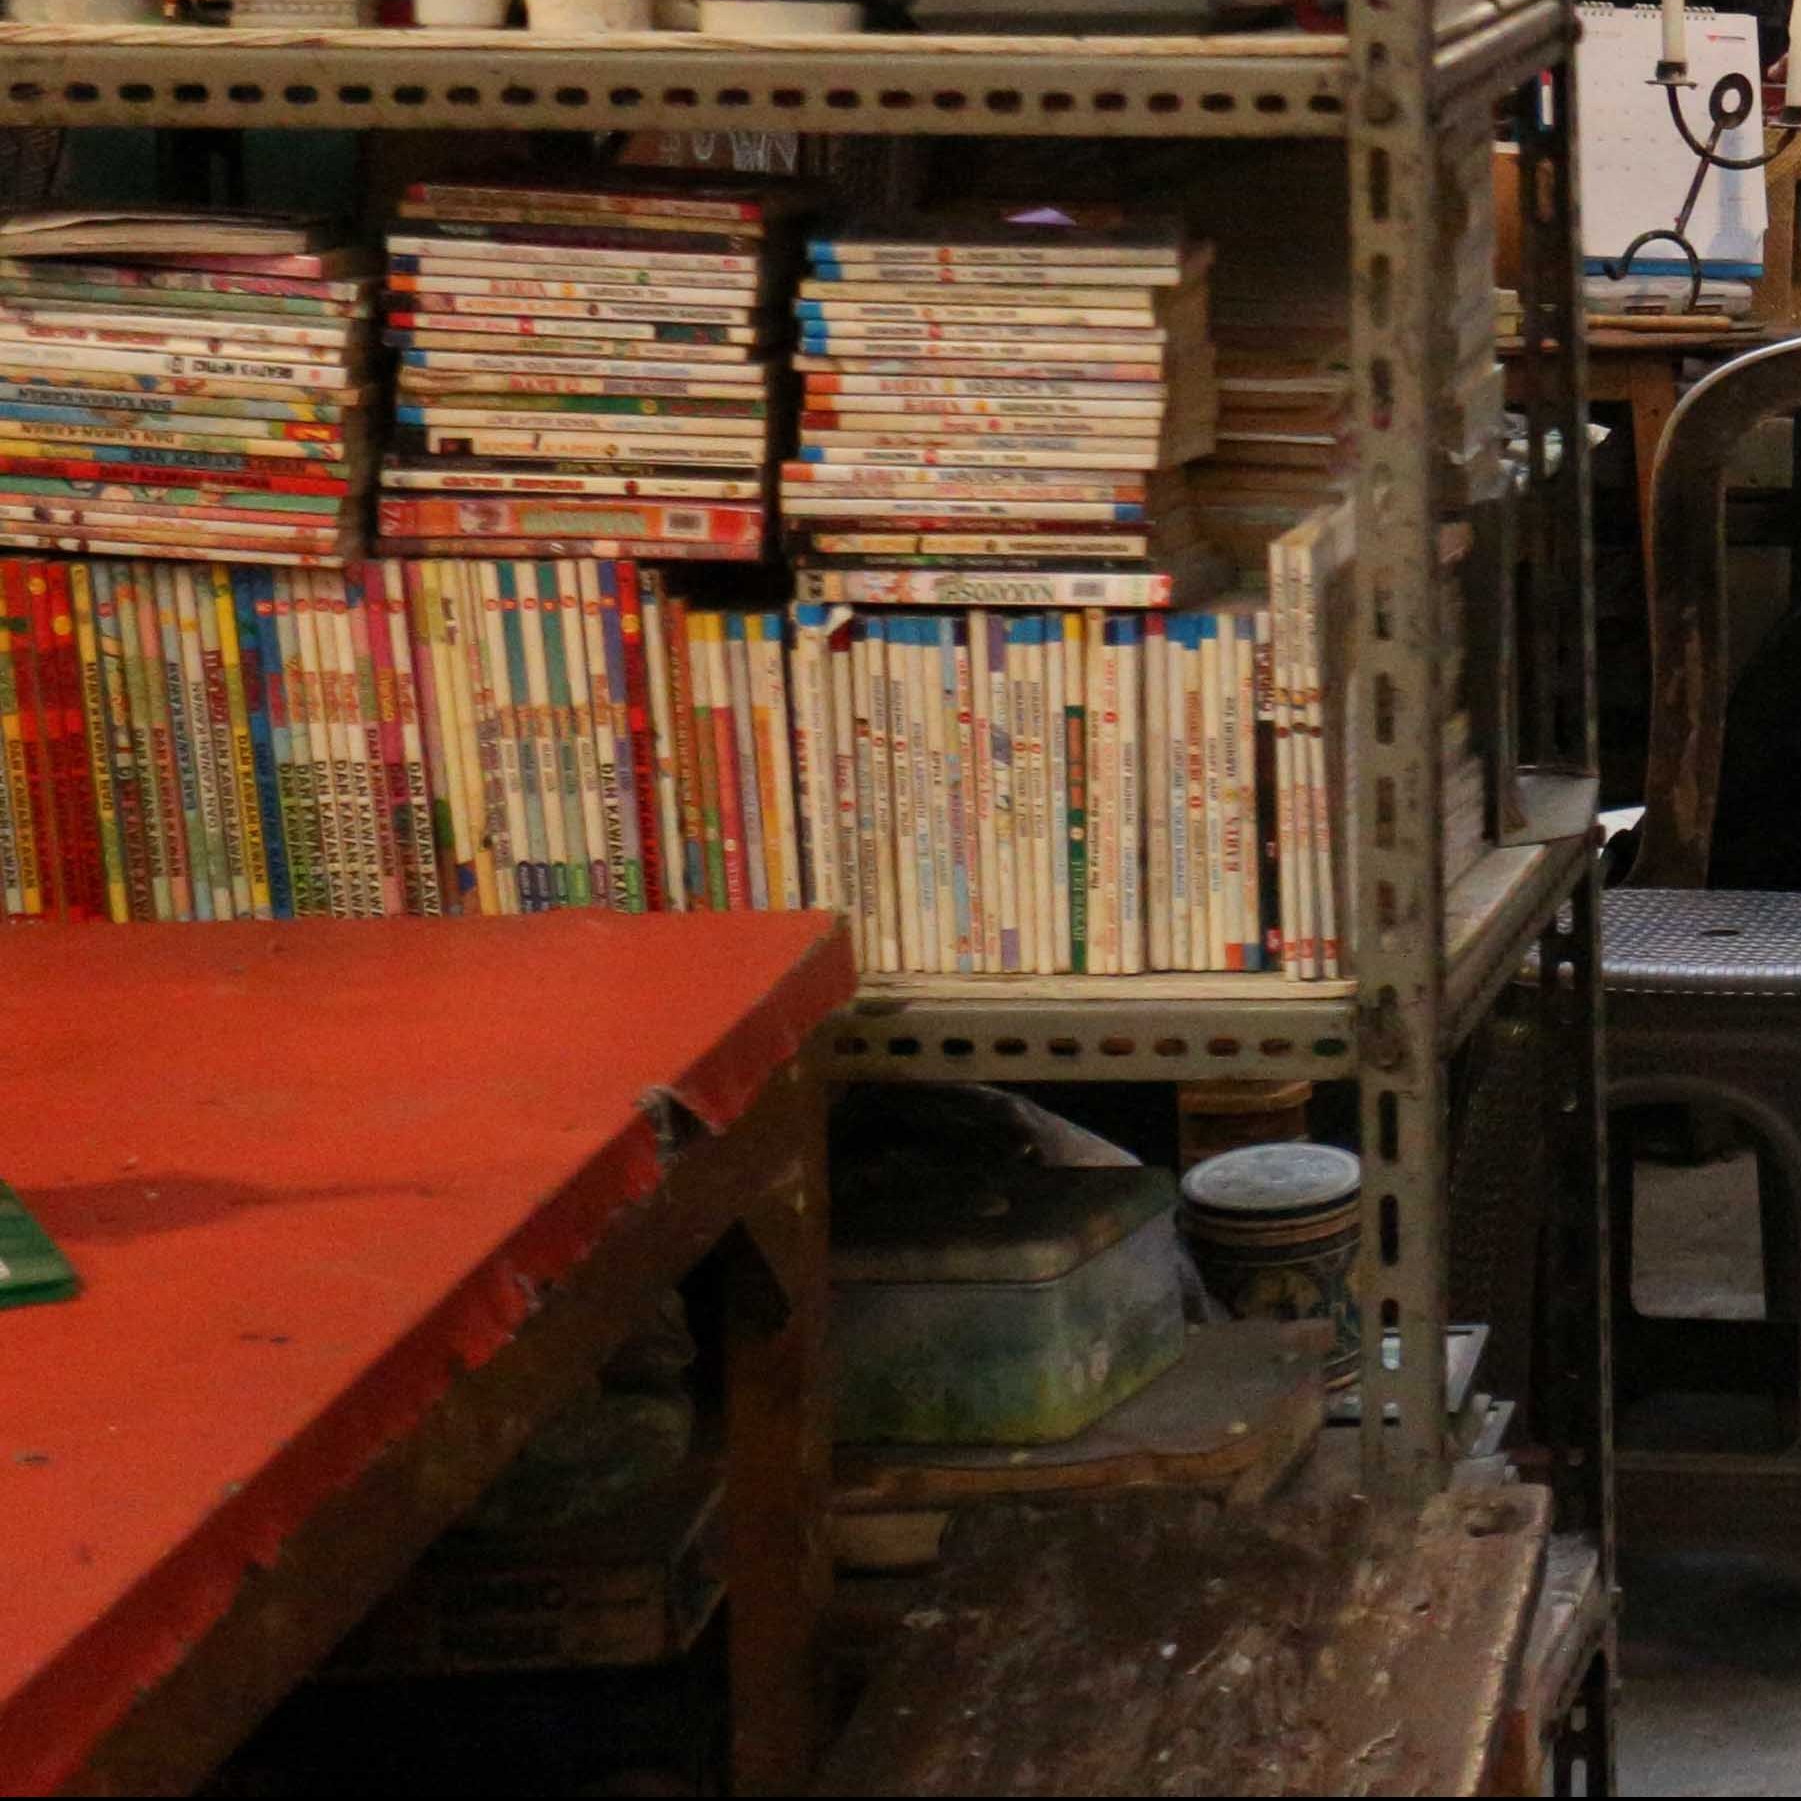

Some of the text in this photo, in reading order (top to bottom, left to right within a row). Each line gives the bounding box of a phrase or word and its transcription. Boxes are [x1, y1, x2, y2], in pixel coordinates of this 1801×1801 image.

[315, 761, 330, 796] DAN
[334, 760, 351, 796] DAN
[352, 762, 368, 797] DAN
[407, 761, 425, 797] DAN
[601, 763, 617, 798] DAN
